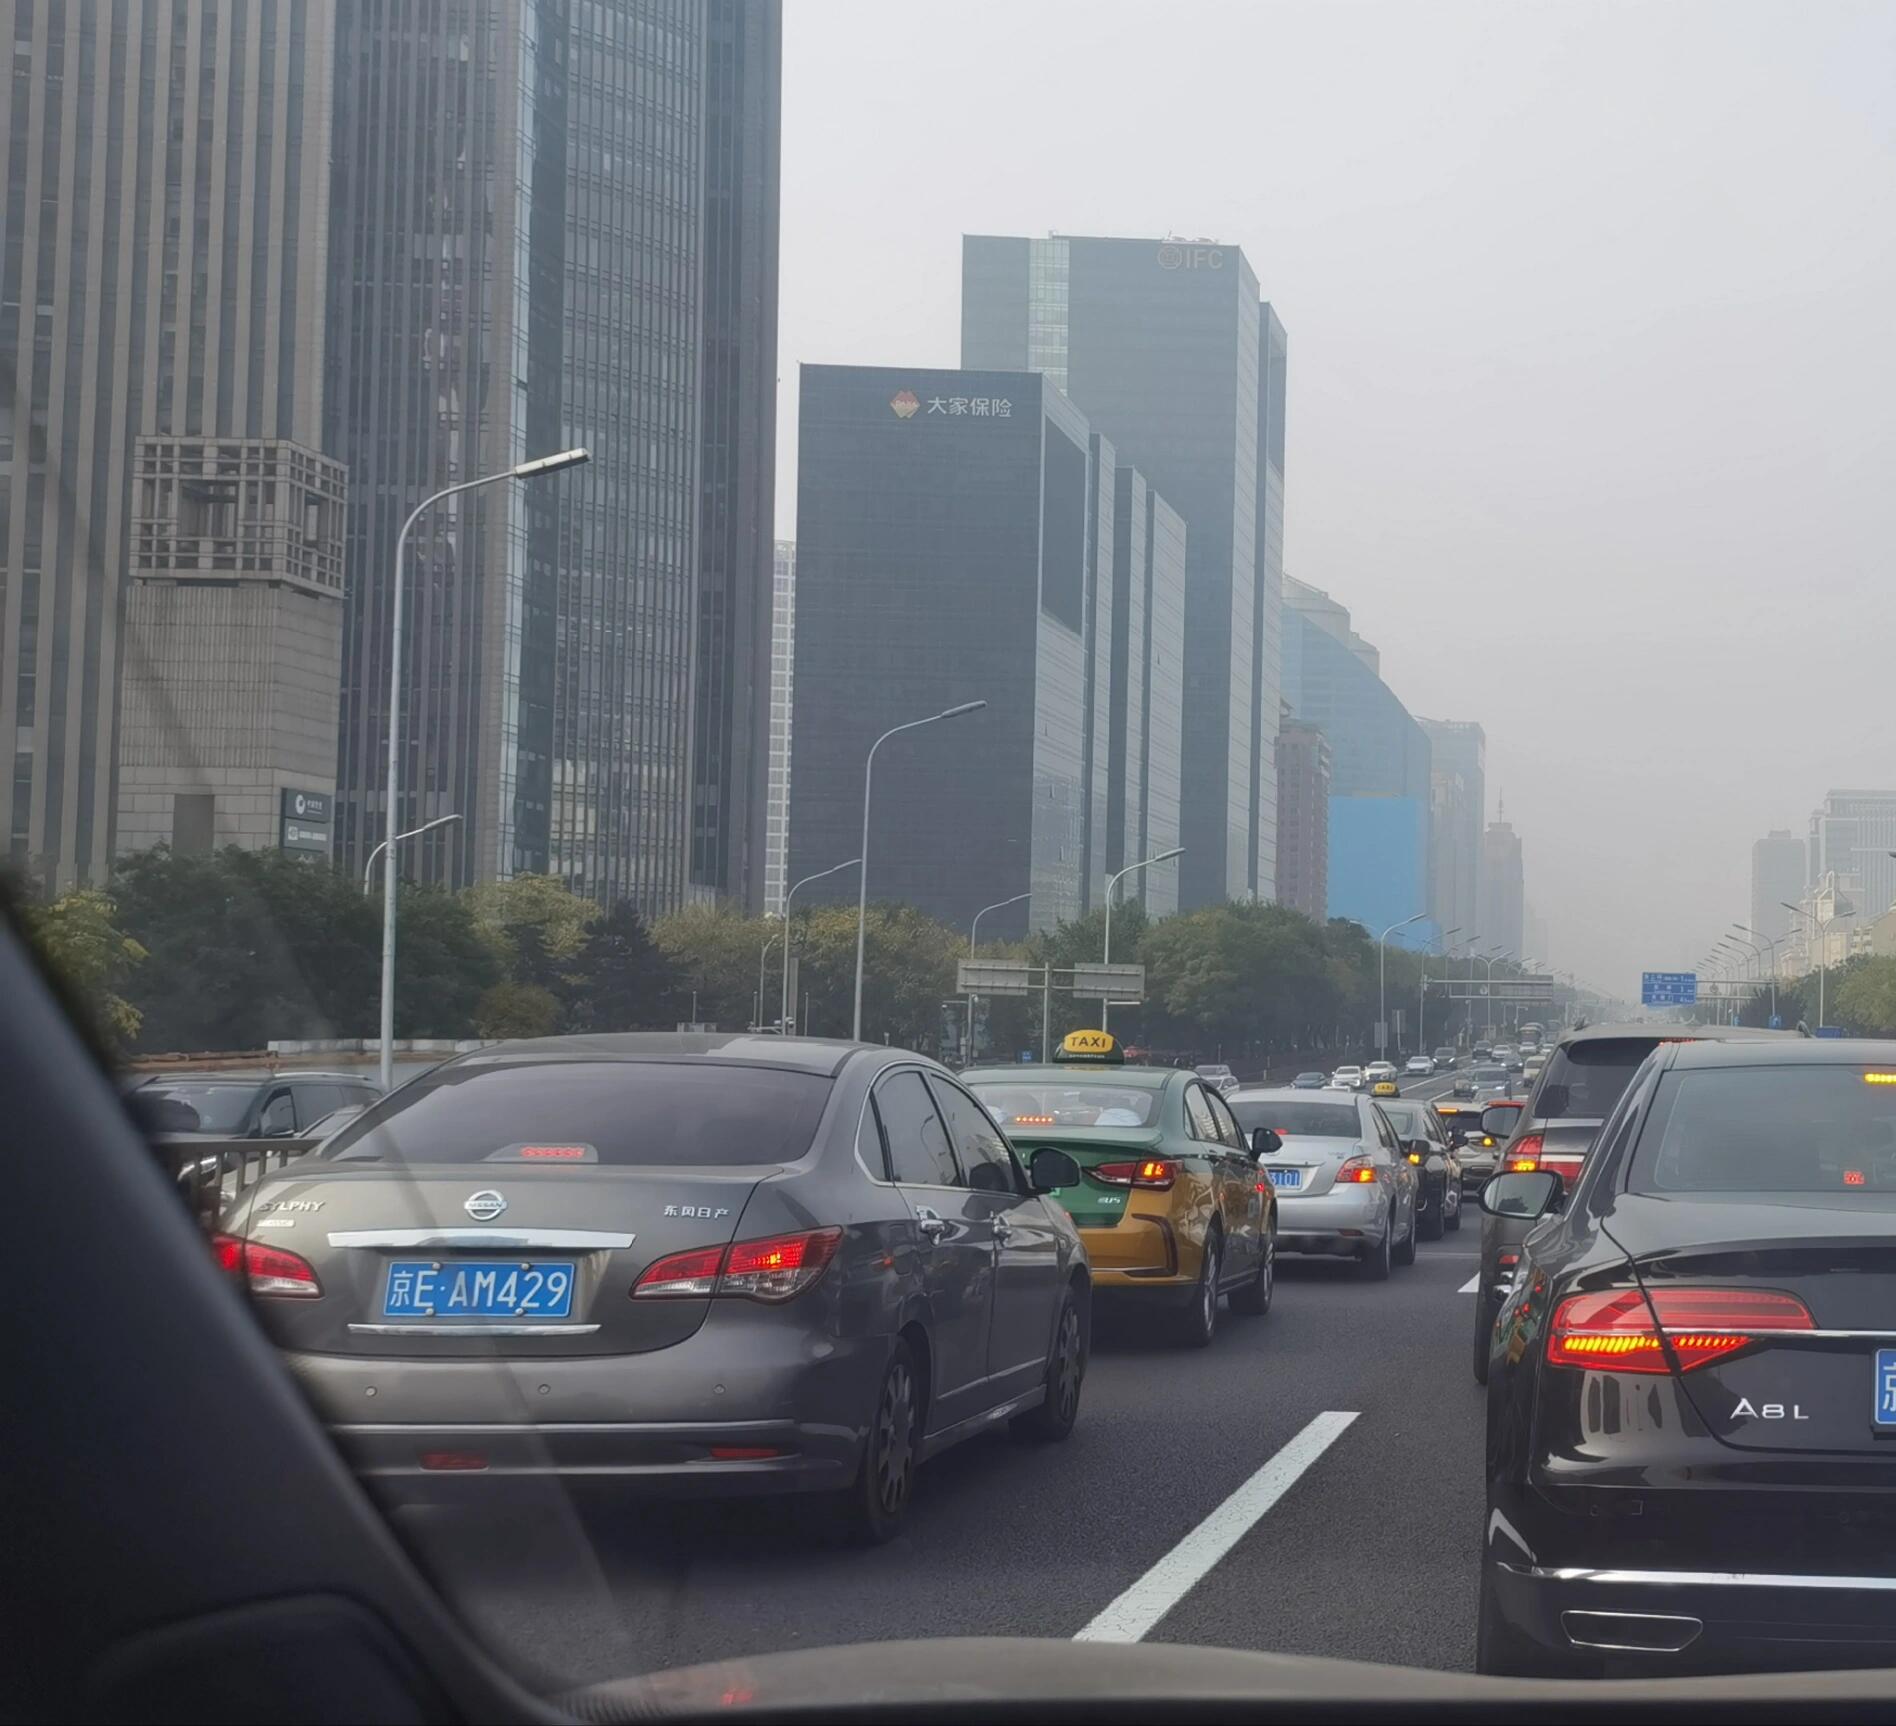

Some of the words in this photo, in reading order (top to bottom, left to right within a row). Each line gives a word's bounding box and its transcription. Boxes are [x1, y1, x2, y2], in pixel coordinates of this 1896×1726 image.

[1186, 248, 1224, 270] IFC
[927, 396, 1013, 418] 大家保险
[1071, 1036, 1106, 1048] TAXI
[259, 1200, 326, 1212] SYLPHY
[663, 1205, 729, 1219] 东风日产
